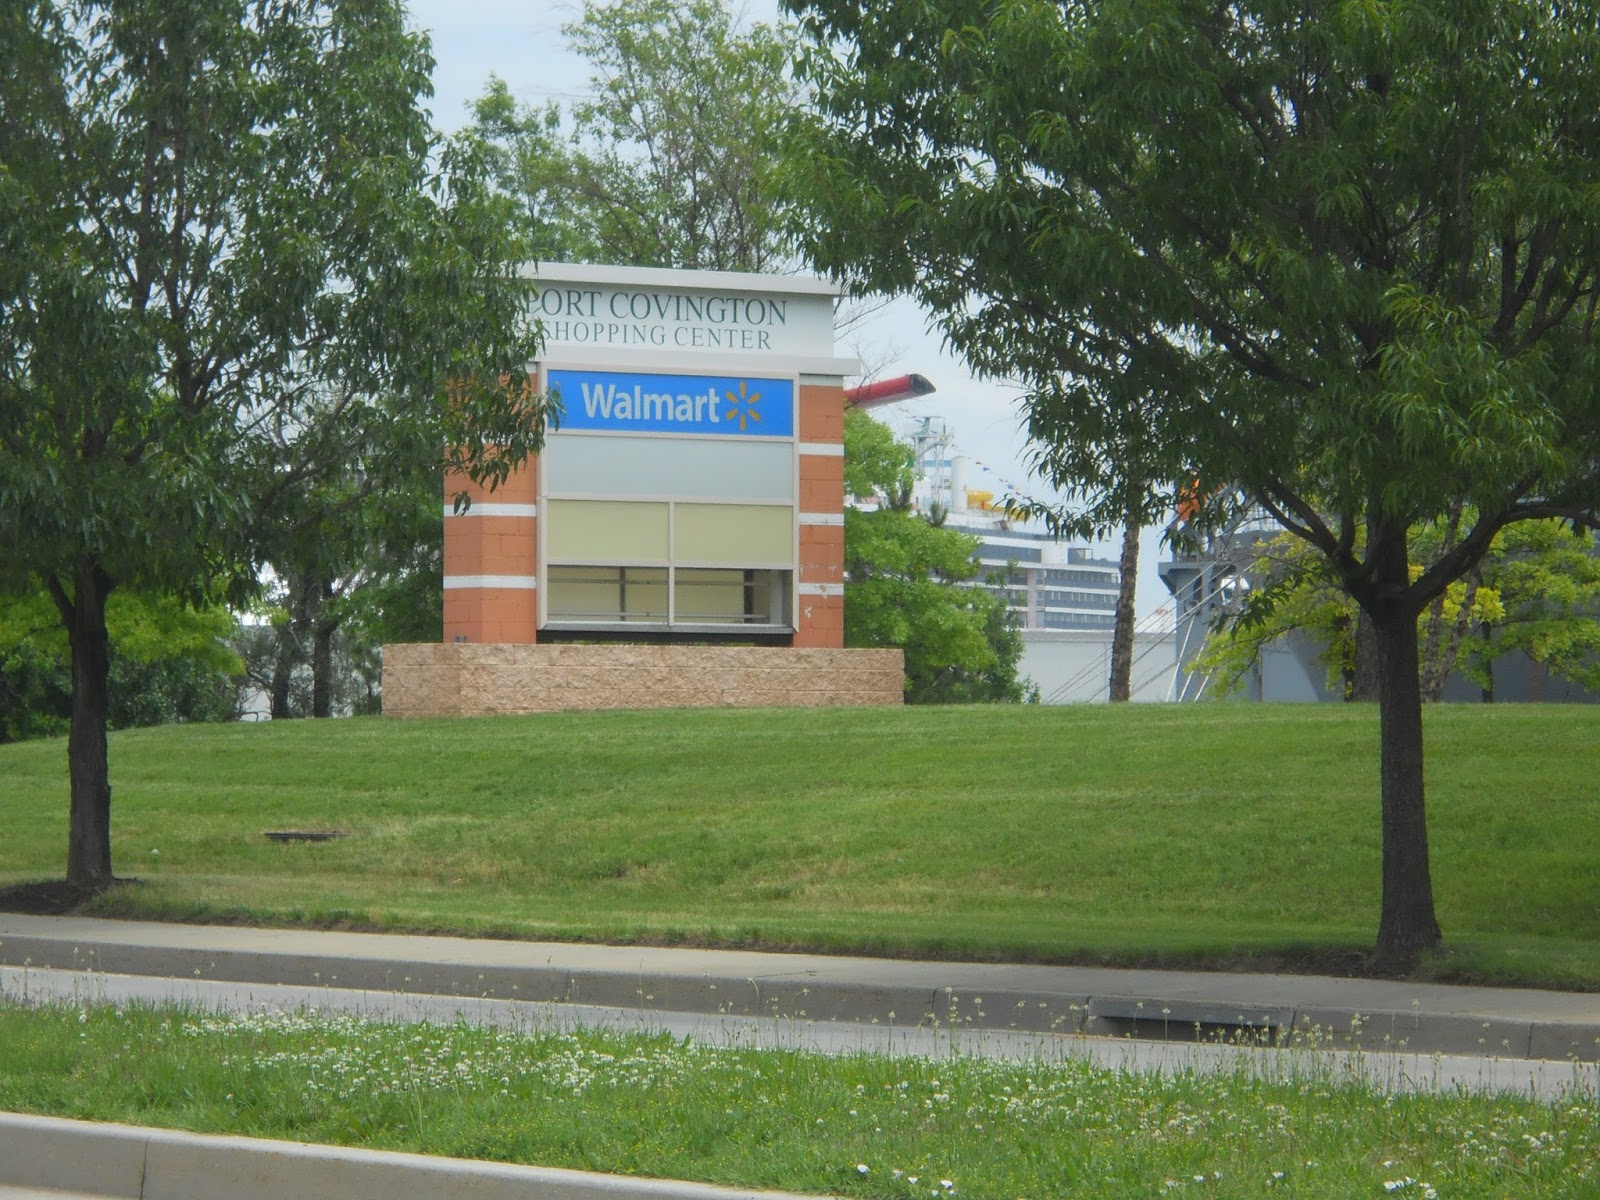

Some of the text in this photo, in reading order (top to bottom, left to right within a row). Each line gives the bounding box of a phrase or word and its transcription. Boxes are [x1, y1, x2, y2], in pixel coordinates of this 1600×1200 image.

[524, 288, 787, 325] PORT COVINGTON
[541, 320, 771, 350] SHOPPING CENTER
[581, 383, 720, 423] Walmart
